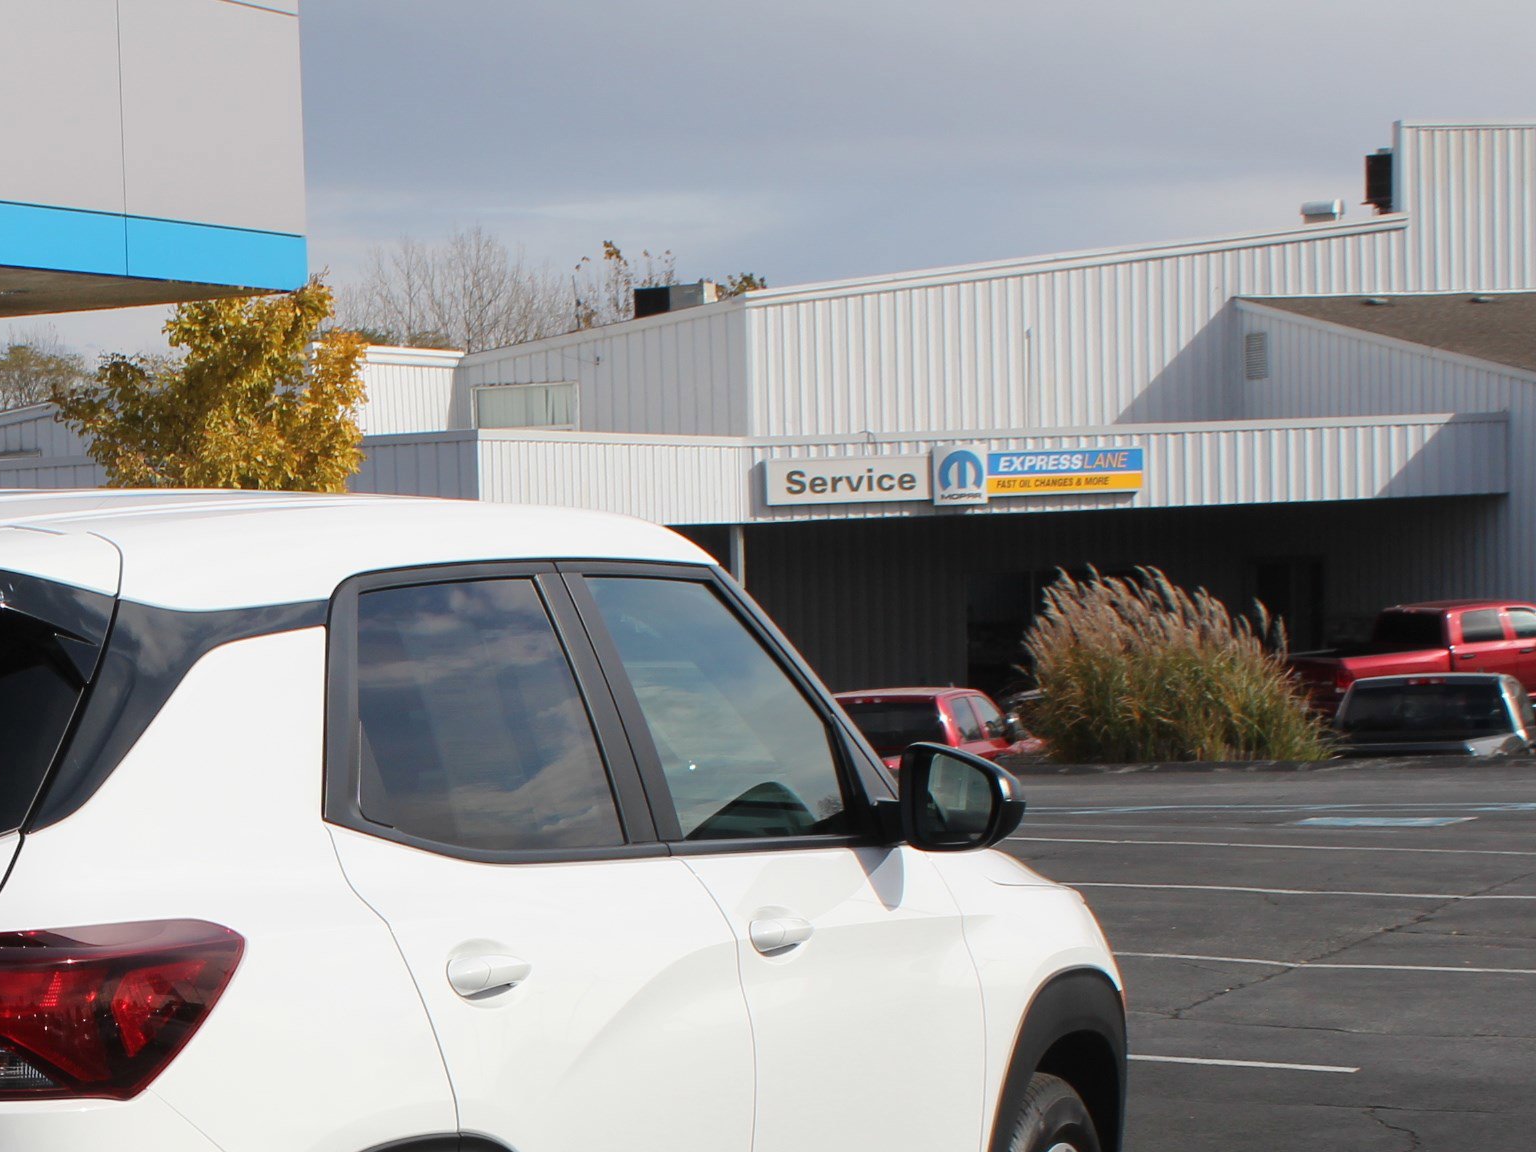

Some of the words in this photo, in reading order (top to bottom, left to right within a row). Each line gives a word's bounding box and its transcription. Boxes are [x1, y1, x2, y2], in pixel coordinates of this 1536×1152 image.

[785, 468, 917, 495] Service
[995, 479, 1017, 489] FAST
[1019, 479, 1033, 488] OIL
[1034, 477, 1074, 488] CHANGES
[1075, 477, 1082, 486] &
[1084, 476, 1110, 486] MORE
